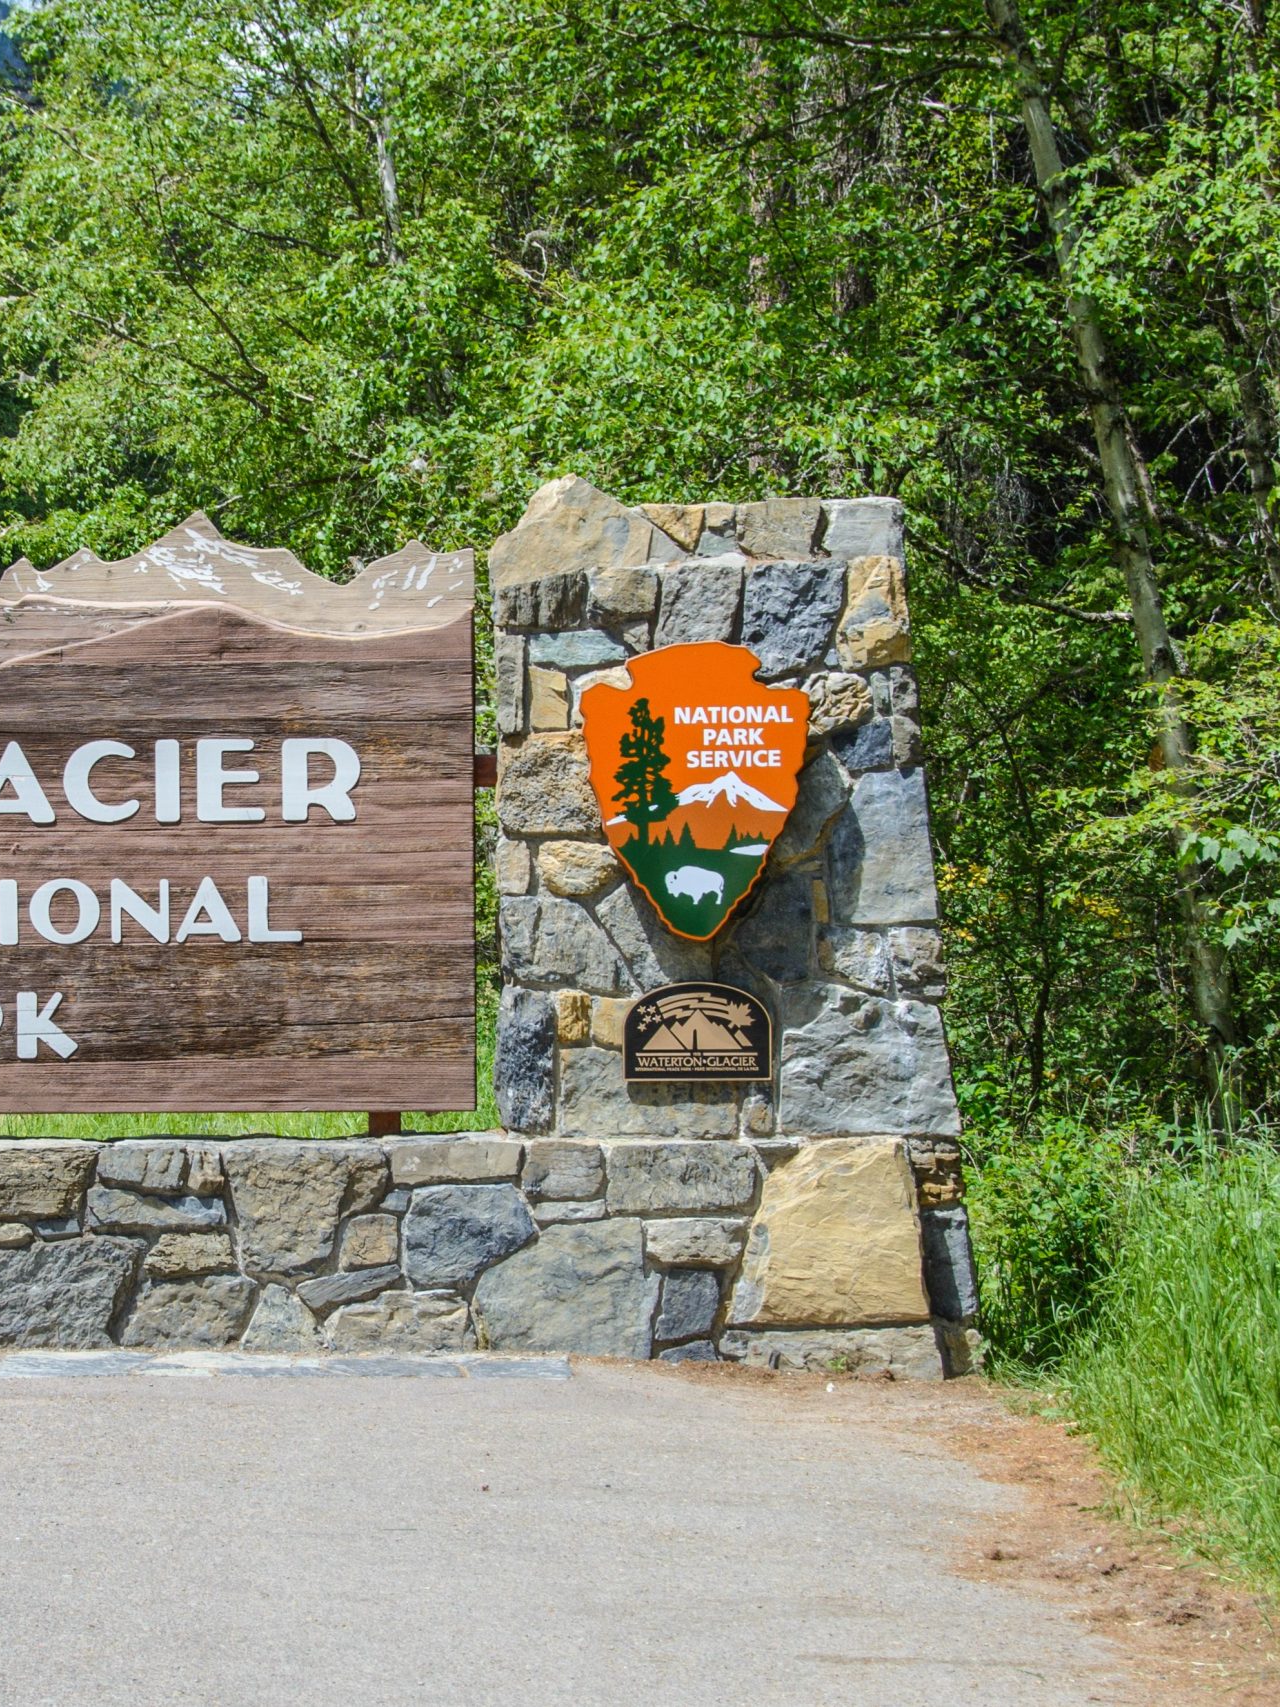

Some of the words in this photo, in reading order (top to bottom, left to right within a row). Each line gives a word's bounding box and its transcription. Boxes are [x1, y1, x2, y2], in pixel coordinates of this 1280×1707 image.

[674, 705, 793, 724] NATIONAL
[702, 727, 764, 746] PARK
[686, 749, 781, 768] SERVICE
